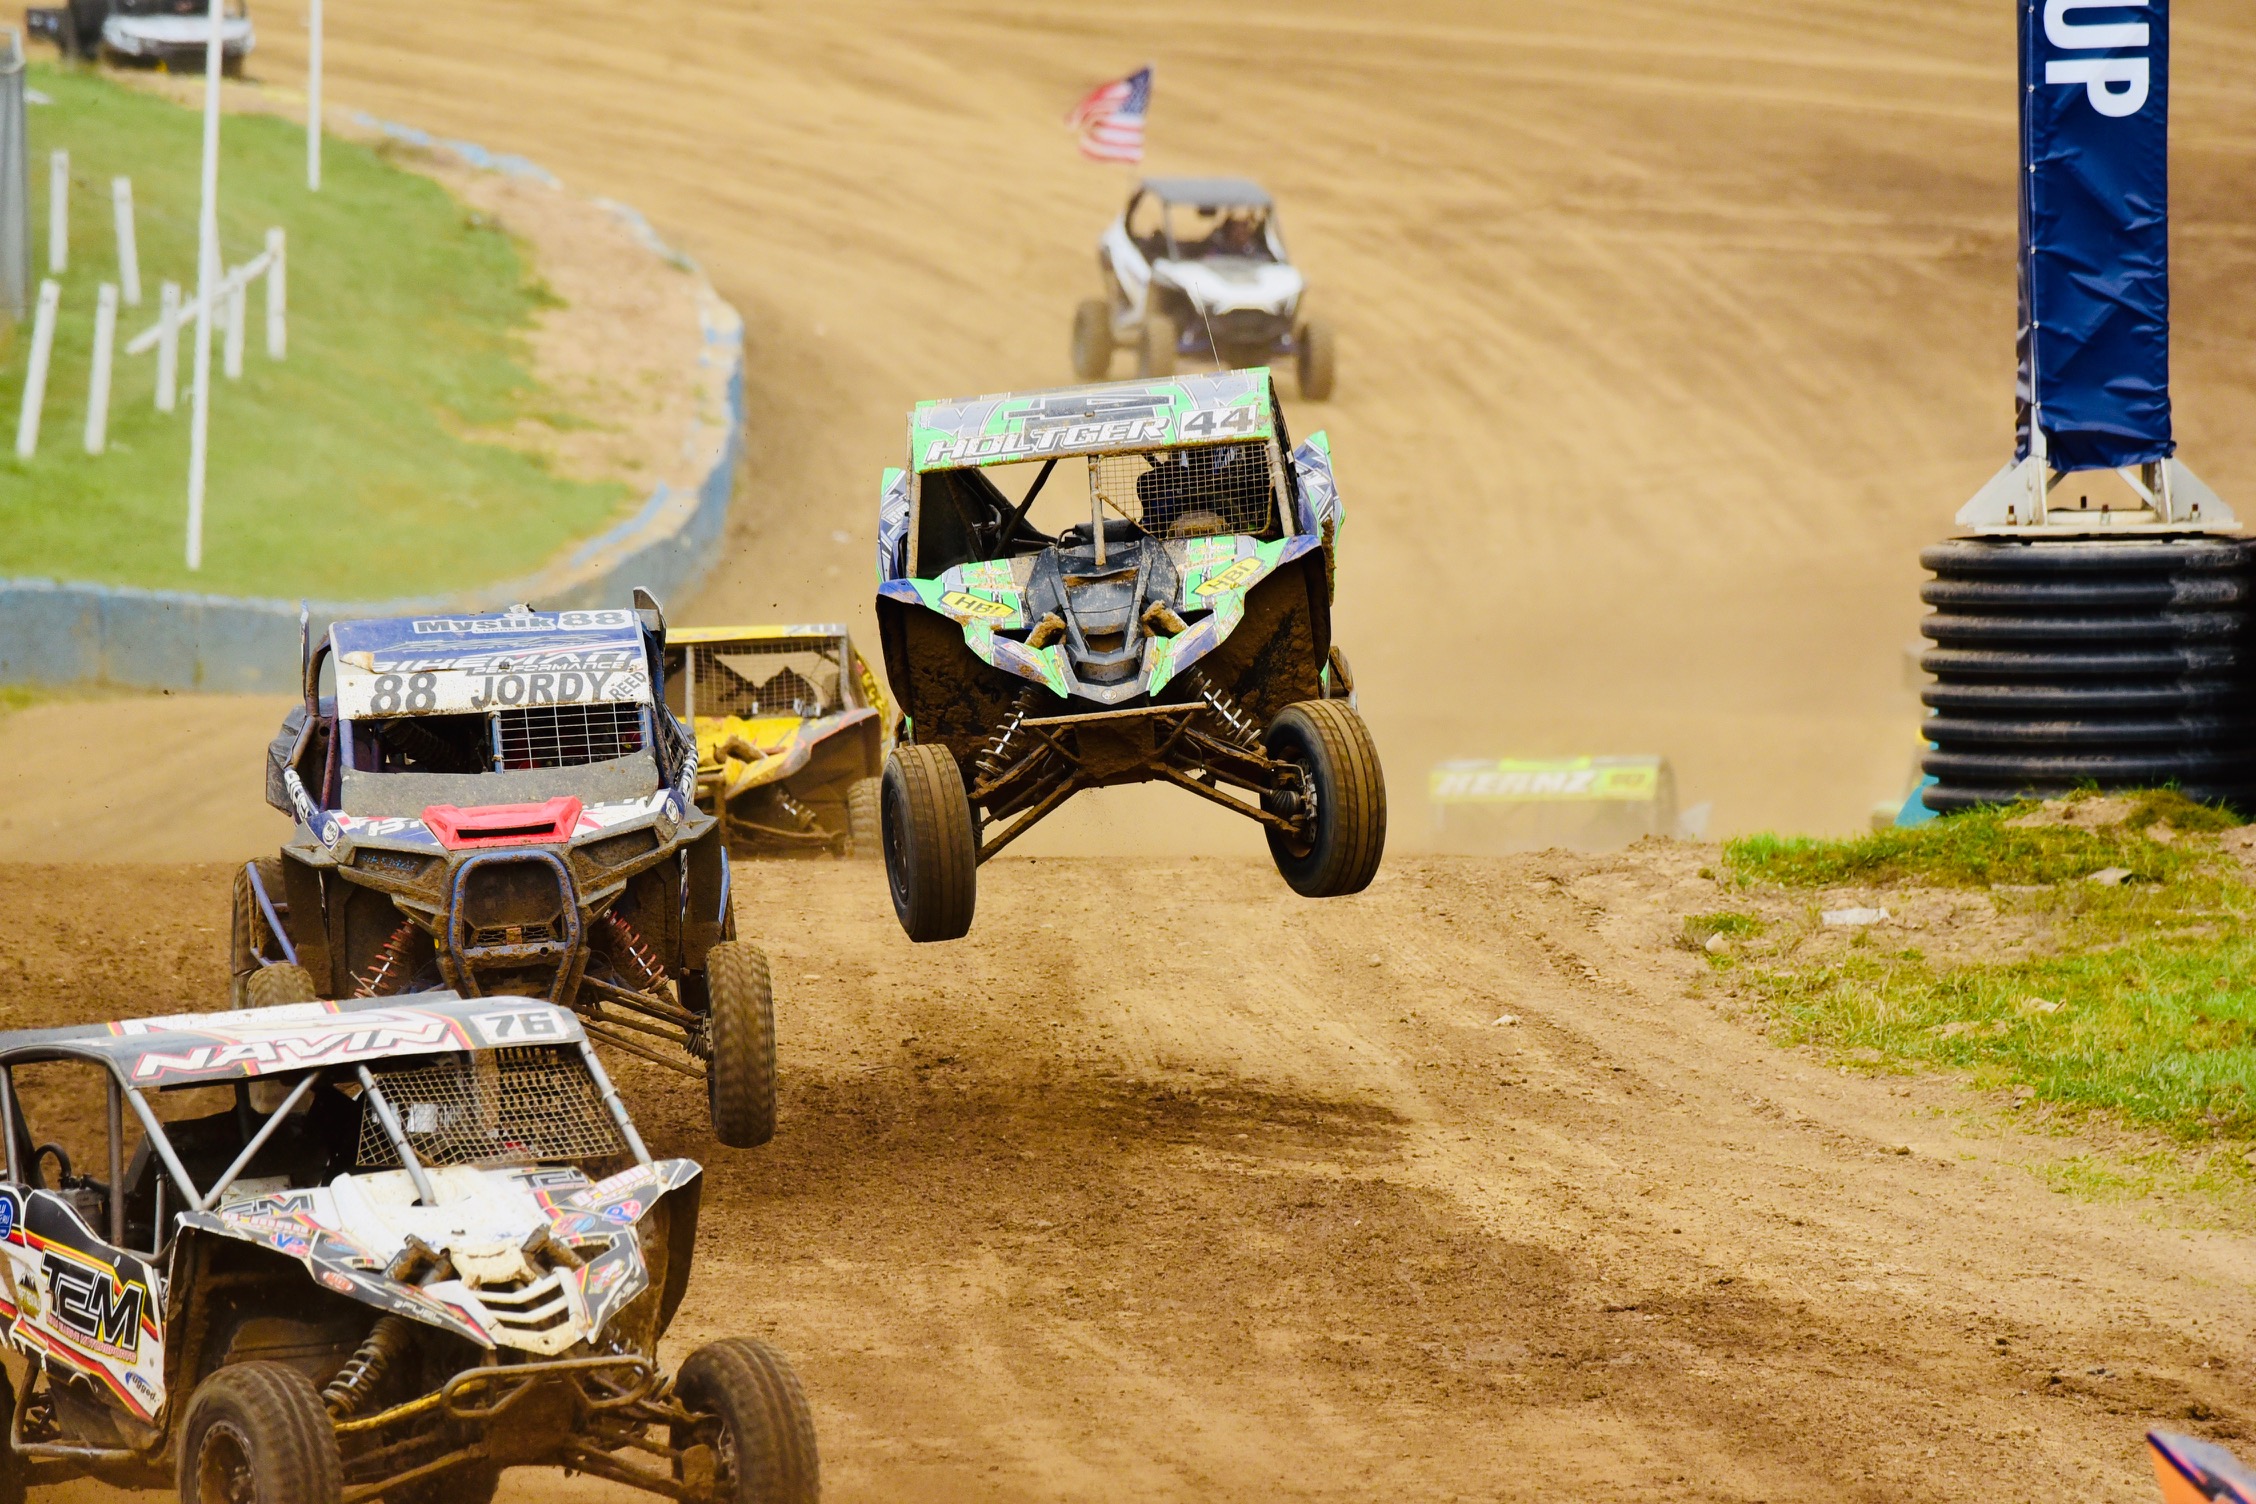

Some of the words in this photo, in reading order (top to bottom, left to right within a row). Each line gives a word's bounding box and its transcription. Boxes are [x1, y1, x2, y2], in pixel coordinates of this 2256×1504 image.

[2043, 0, 2150, 118] UP
[923, 416, 1172, 465] HOLTGER
[1183, 409, 1253, 437] 44
[561, 611, 626, 626] 88
[369, 671, 438, 714] 88
[470, 670, 614, 709] JORDY
[472, 660, 624, 674] PERFORMANCE
[608, 670, 648, 702] REED
[132, 1024, 451, 1077] NAVIN
[484, 1011, 554, 1039] 76
[41, 1247, 146, 1351] TEM
